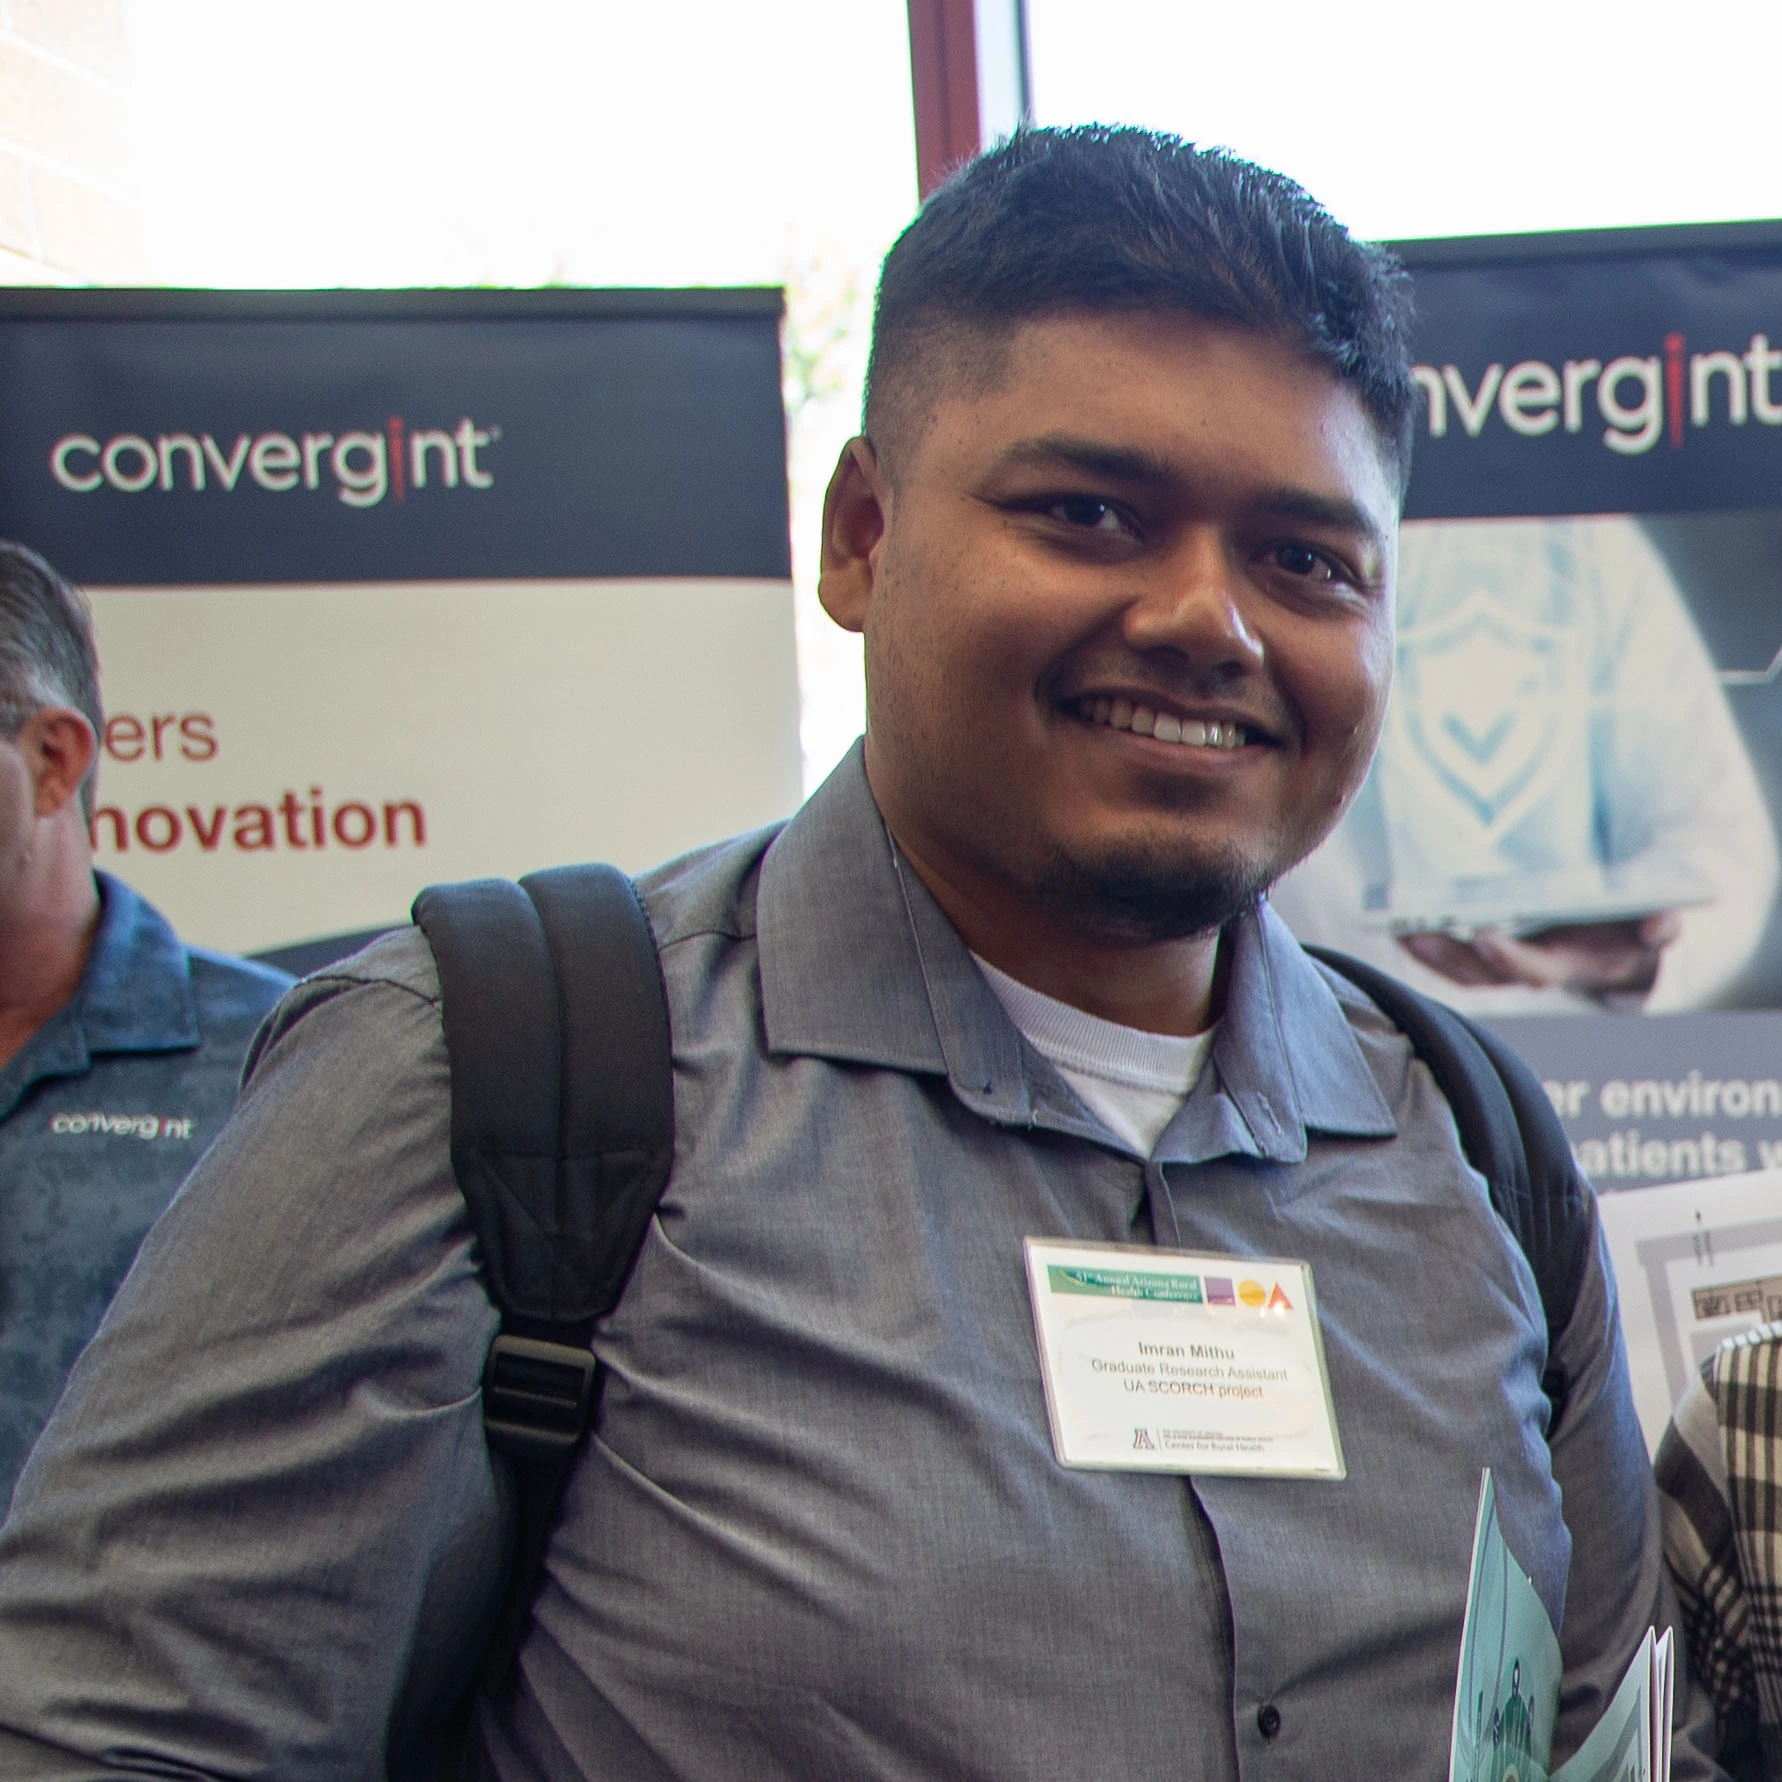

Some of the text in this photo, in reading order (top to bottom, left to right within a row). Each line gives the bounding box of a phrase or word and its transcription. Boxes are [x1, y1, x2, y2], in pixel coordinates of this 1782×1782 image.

[50, 416, 493, 508] convergint
[104, 710, 219, 762] ers
[89, 785, 427, 854] novation
[50, 1111, 193, 1141] convergint
[1572, 1128, 1747, 1178] atients
[1091, 1358, 1288, 1382] Graduate Research Assistant
[1138, 1341, 1185, 1359] Imran
[1123, 1379, 1264, 1399] UA SCORCH project
